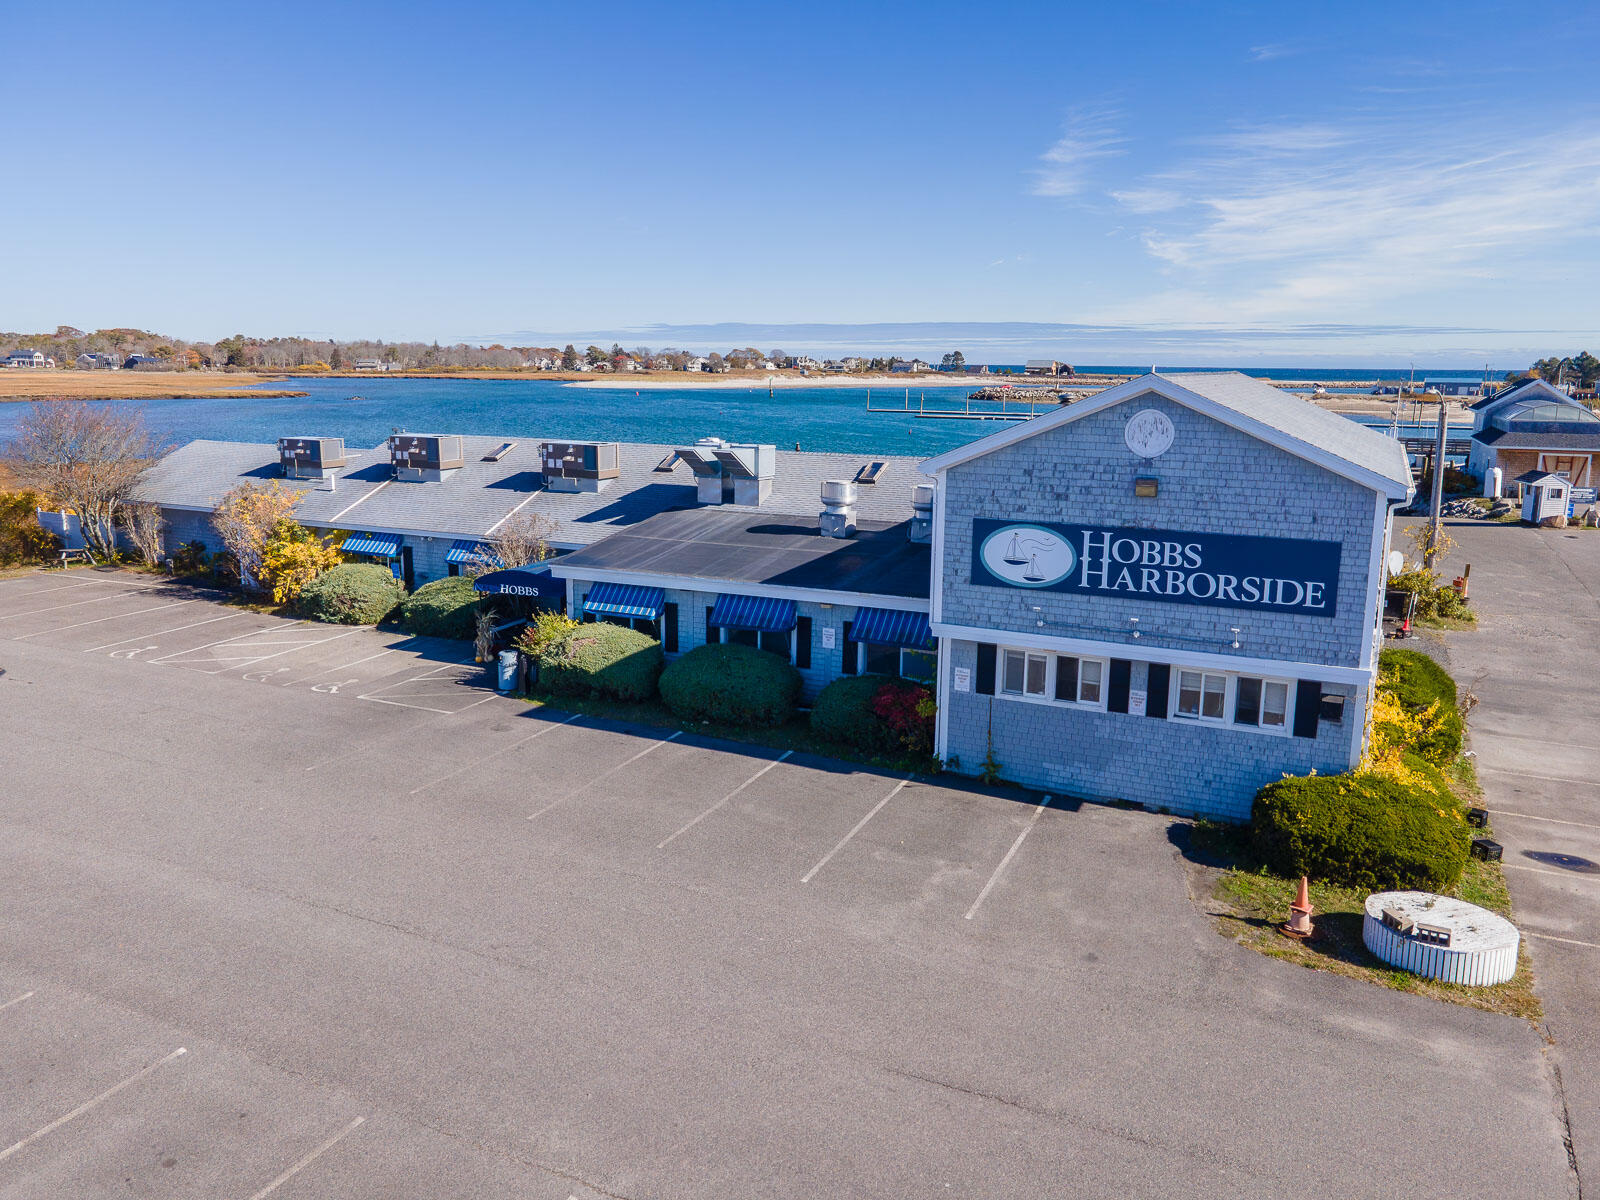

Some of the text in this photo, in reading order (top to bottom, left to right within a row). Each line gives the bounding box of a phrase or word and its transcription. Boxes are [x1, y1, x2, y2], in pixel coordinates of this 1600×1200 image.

[1080, 530, 1202, 568] HOBBS
[500, 584, 539, 597] HOBBS
[1078, 557, 1326, 608] HARBORSIDE
